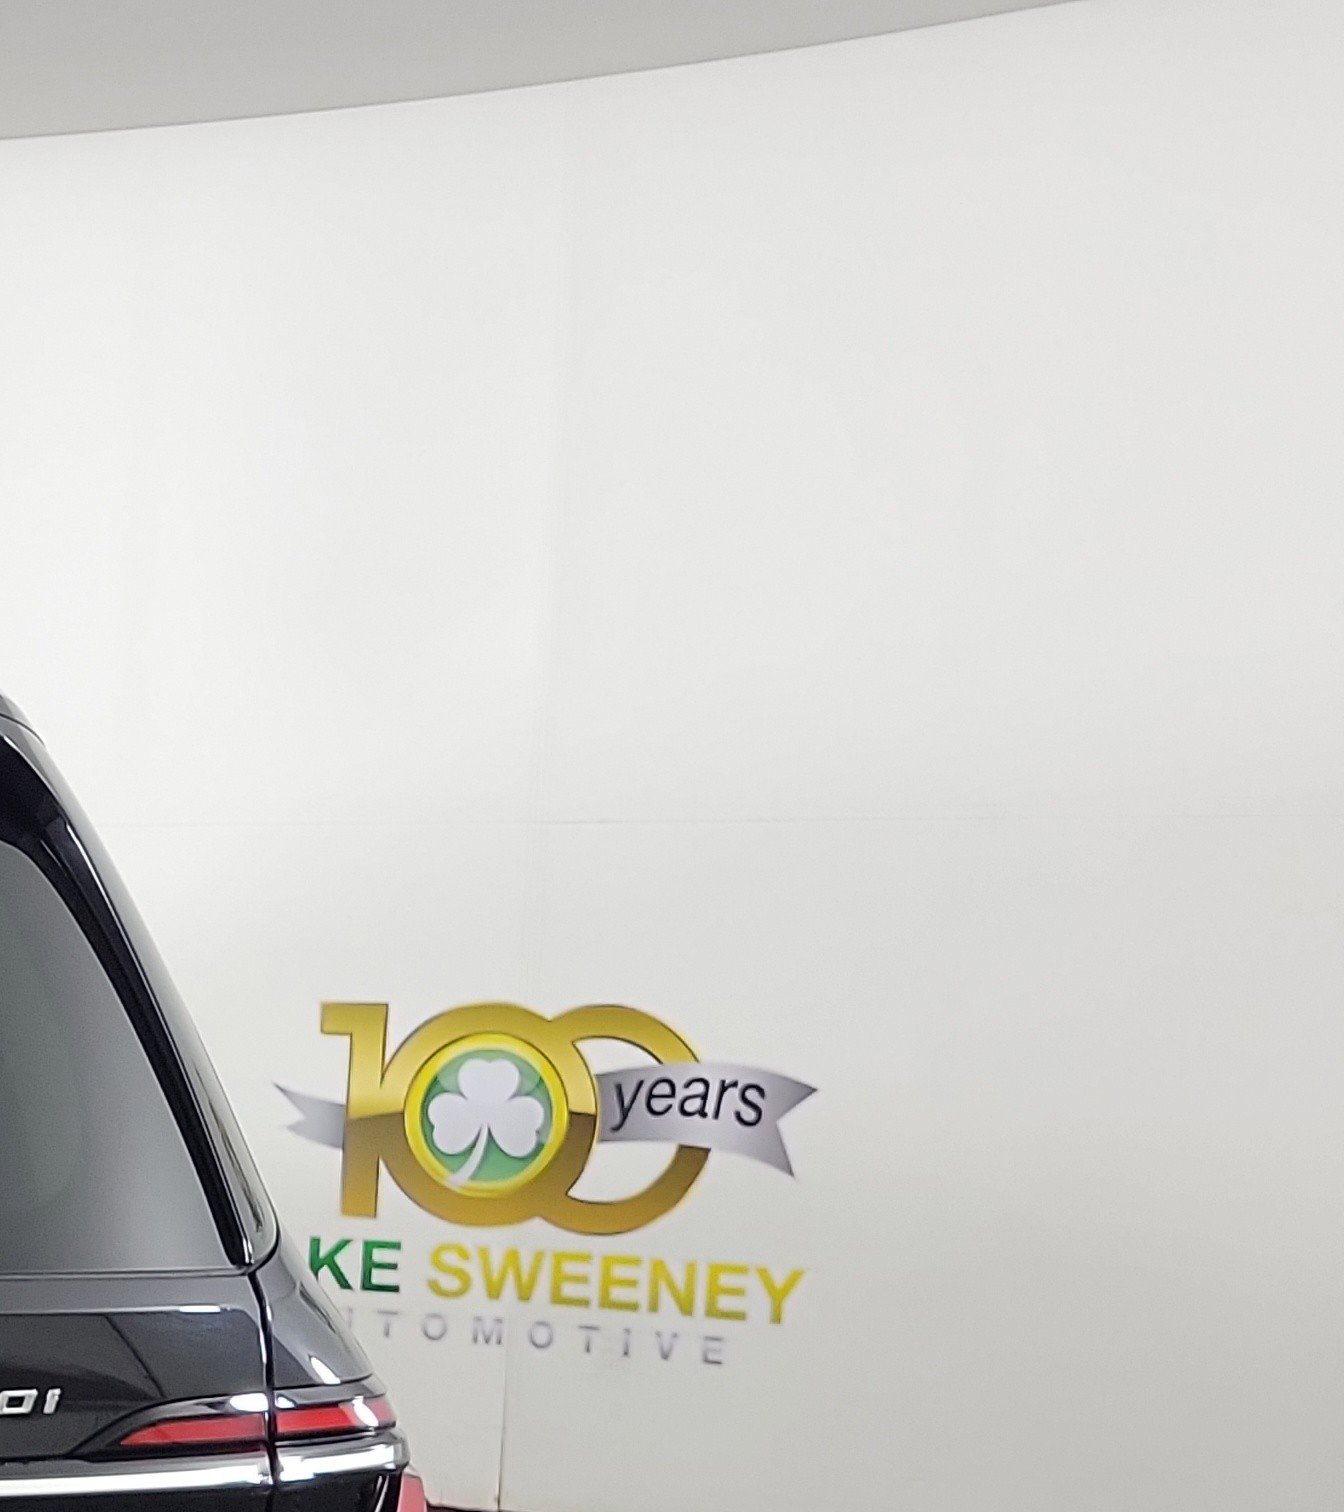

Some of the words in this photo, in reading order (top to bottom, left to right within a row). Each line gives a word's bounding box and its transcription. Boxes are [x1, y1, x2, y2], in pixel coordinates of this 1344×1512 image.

[610, 1075, 767, 1131] years
[309, 1236, 402, 1293] KE
[427, 1242, 805, 1325] SWEENEY
[346, 1306, 728, 1365] TOMOTIVE
